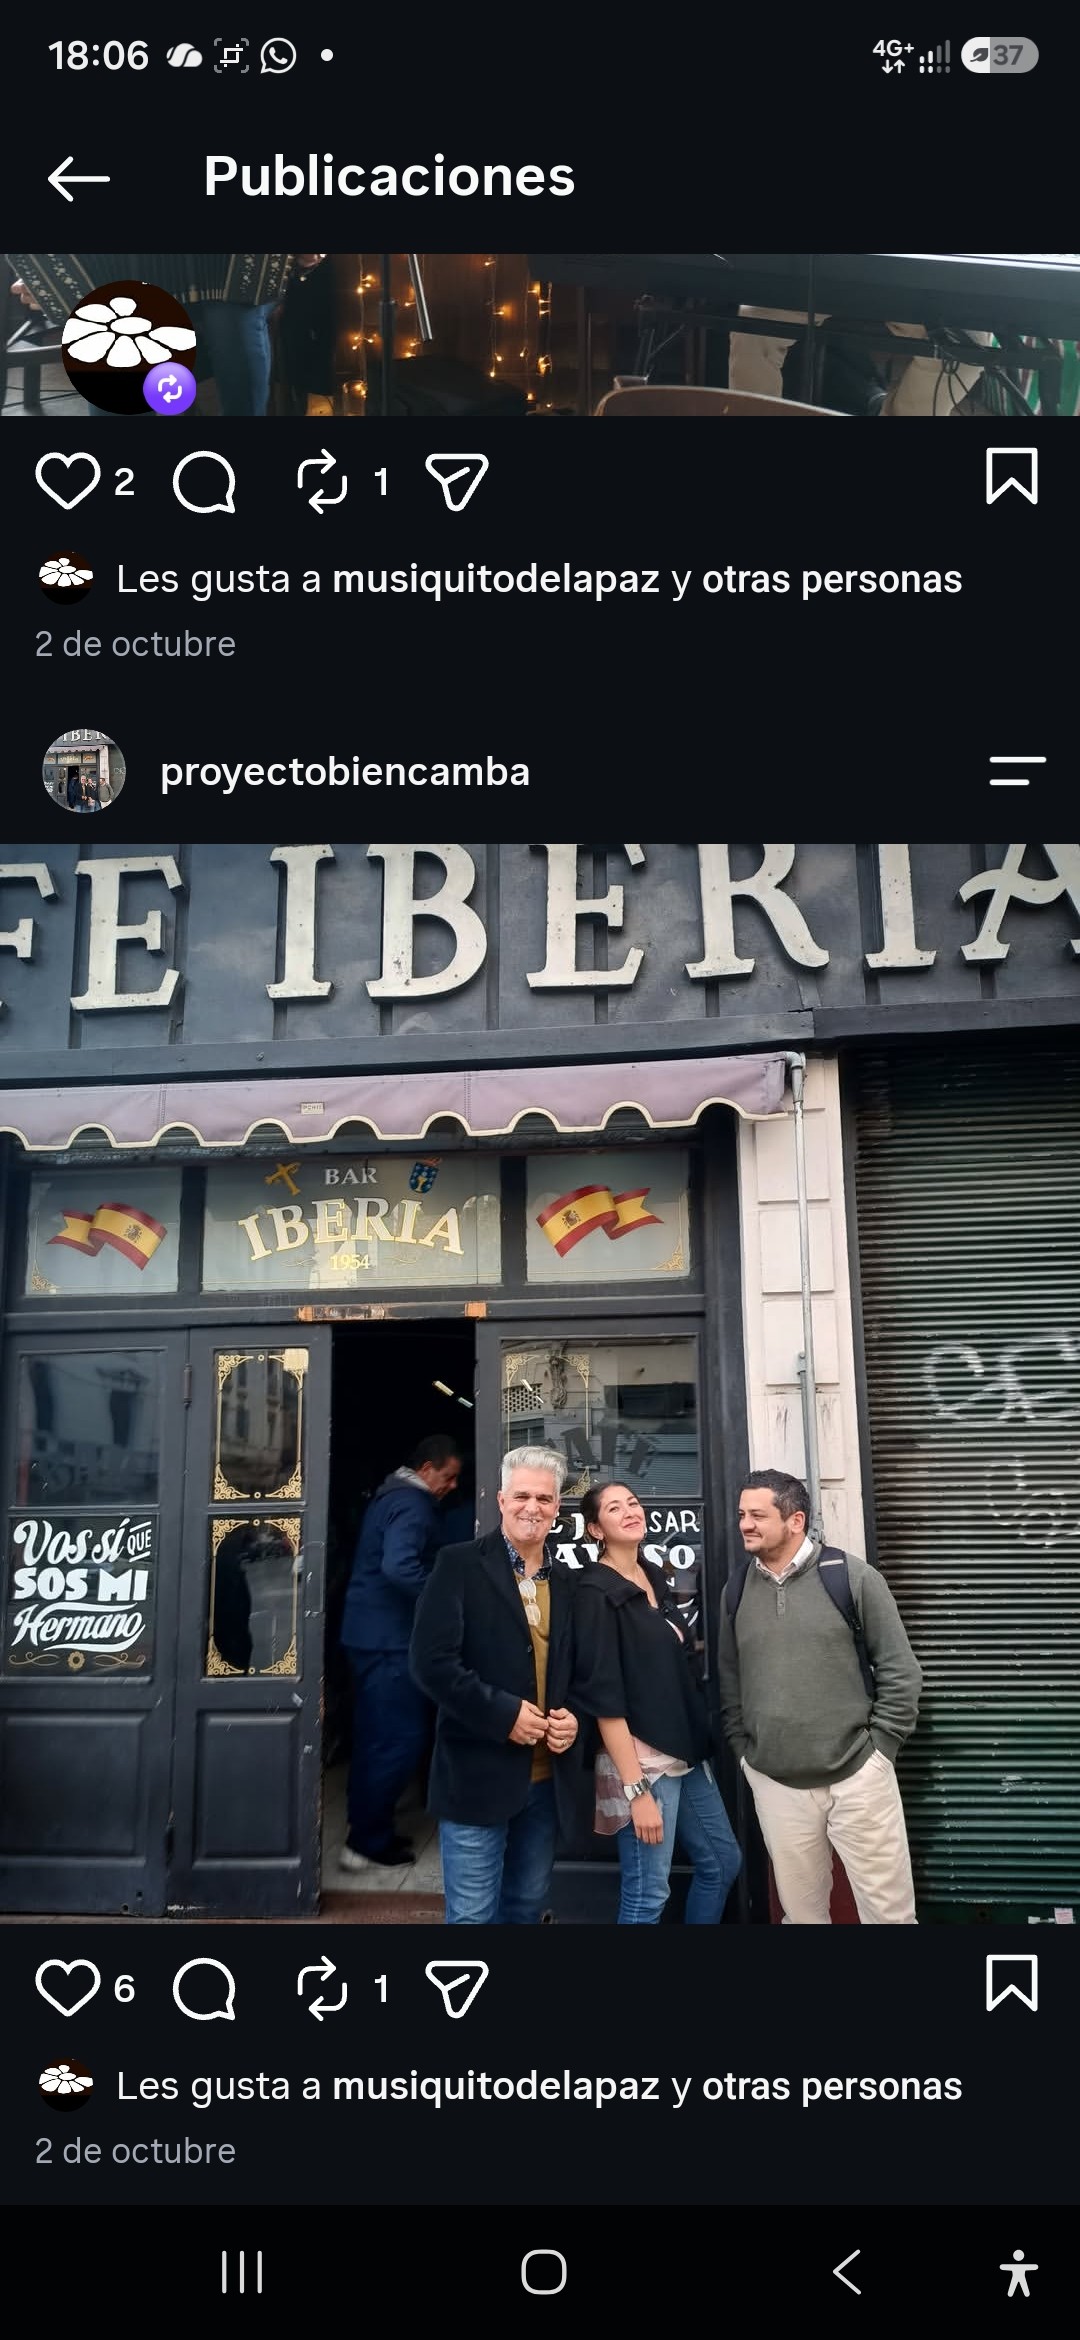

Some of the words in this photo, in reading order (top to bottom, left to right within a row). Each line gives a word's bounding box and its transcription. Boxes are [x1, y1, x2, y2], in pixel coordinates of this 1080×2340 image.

[47, 39, 149, 71] 18:06
[872, 39, 915, 57] 4G+
[993, 44, 1024, 66] 37
[205, 152, 575, 197] Publicaciones
[114, 467, 135, 496] 2
[374, 467, 387, 496] 1
[118, 564, 179, 593] Les
[191, 564, 290, 602] gusta
[302, 570, 321, 593] a
[333, 562, 660, 602] musiquitodelapaz
[670, 570, 693, 602] y
[702, 565, 791, 594] otras
[802, 570, 963, 602] personas
[35, 630, 53, 657] 2
[63, 629, 102, 657] de
[112, 629, 236, 657] octubre
[161, 755, 530, 795] proyectobiencamba
[266, 844, 1080, 1001] IBERIA
[324, 1166, 379, 1186] BAR
[238, 1196, 465, 1261] IBERIA
[329, 1253, 371, 1270] 1954
[13, 1519, 93, 1567] Vos
[91, 1517, 125, 1564] sí
[127, 1529, 152, 1555] QUE
[13, 1566, 89, 1601] SOS
[97, 1568, 149, 1602] MI
[11, 1602, 145, 1650] Hermano
[113, 1974, 136, 2003] 6
[374, 1974, 387, 2003] 1
[118, 2071, 179, 2100] Les
[191, 2071, 290, 2109] gusta
[302, 2077, 321, 2100] a
[333, 2069, 660, 2109] musiquitodelapaz
[670, 2077, 693, 2109] y
[702, 2072, 791, 2101] otras
[802, 2077, 963, 2109] personas
[35, 2137, 53, 2164] 2
[63, 2136, 102, 2164] de
[112, 2136, 236, 2164] octubre
